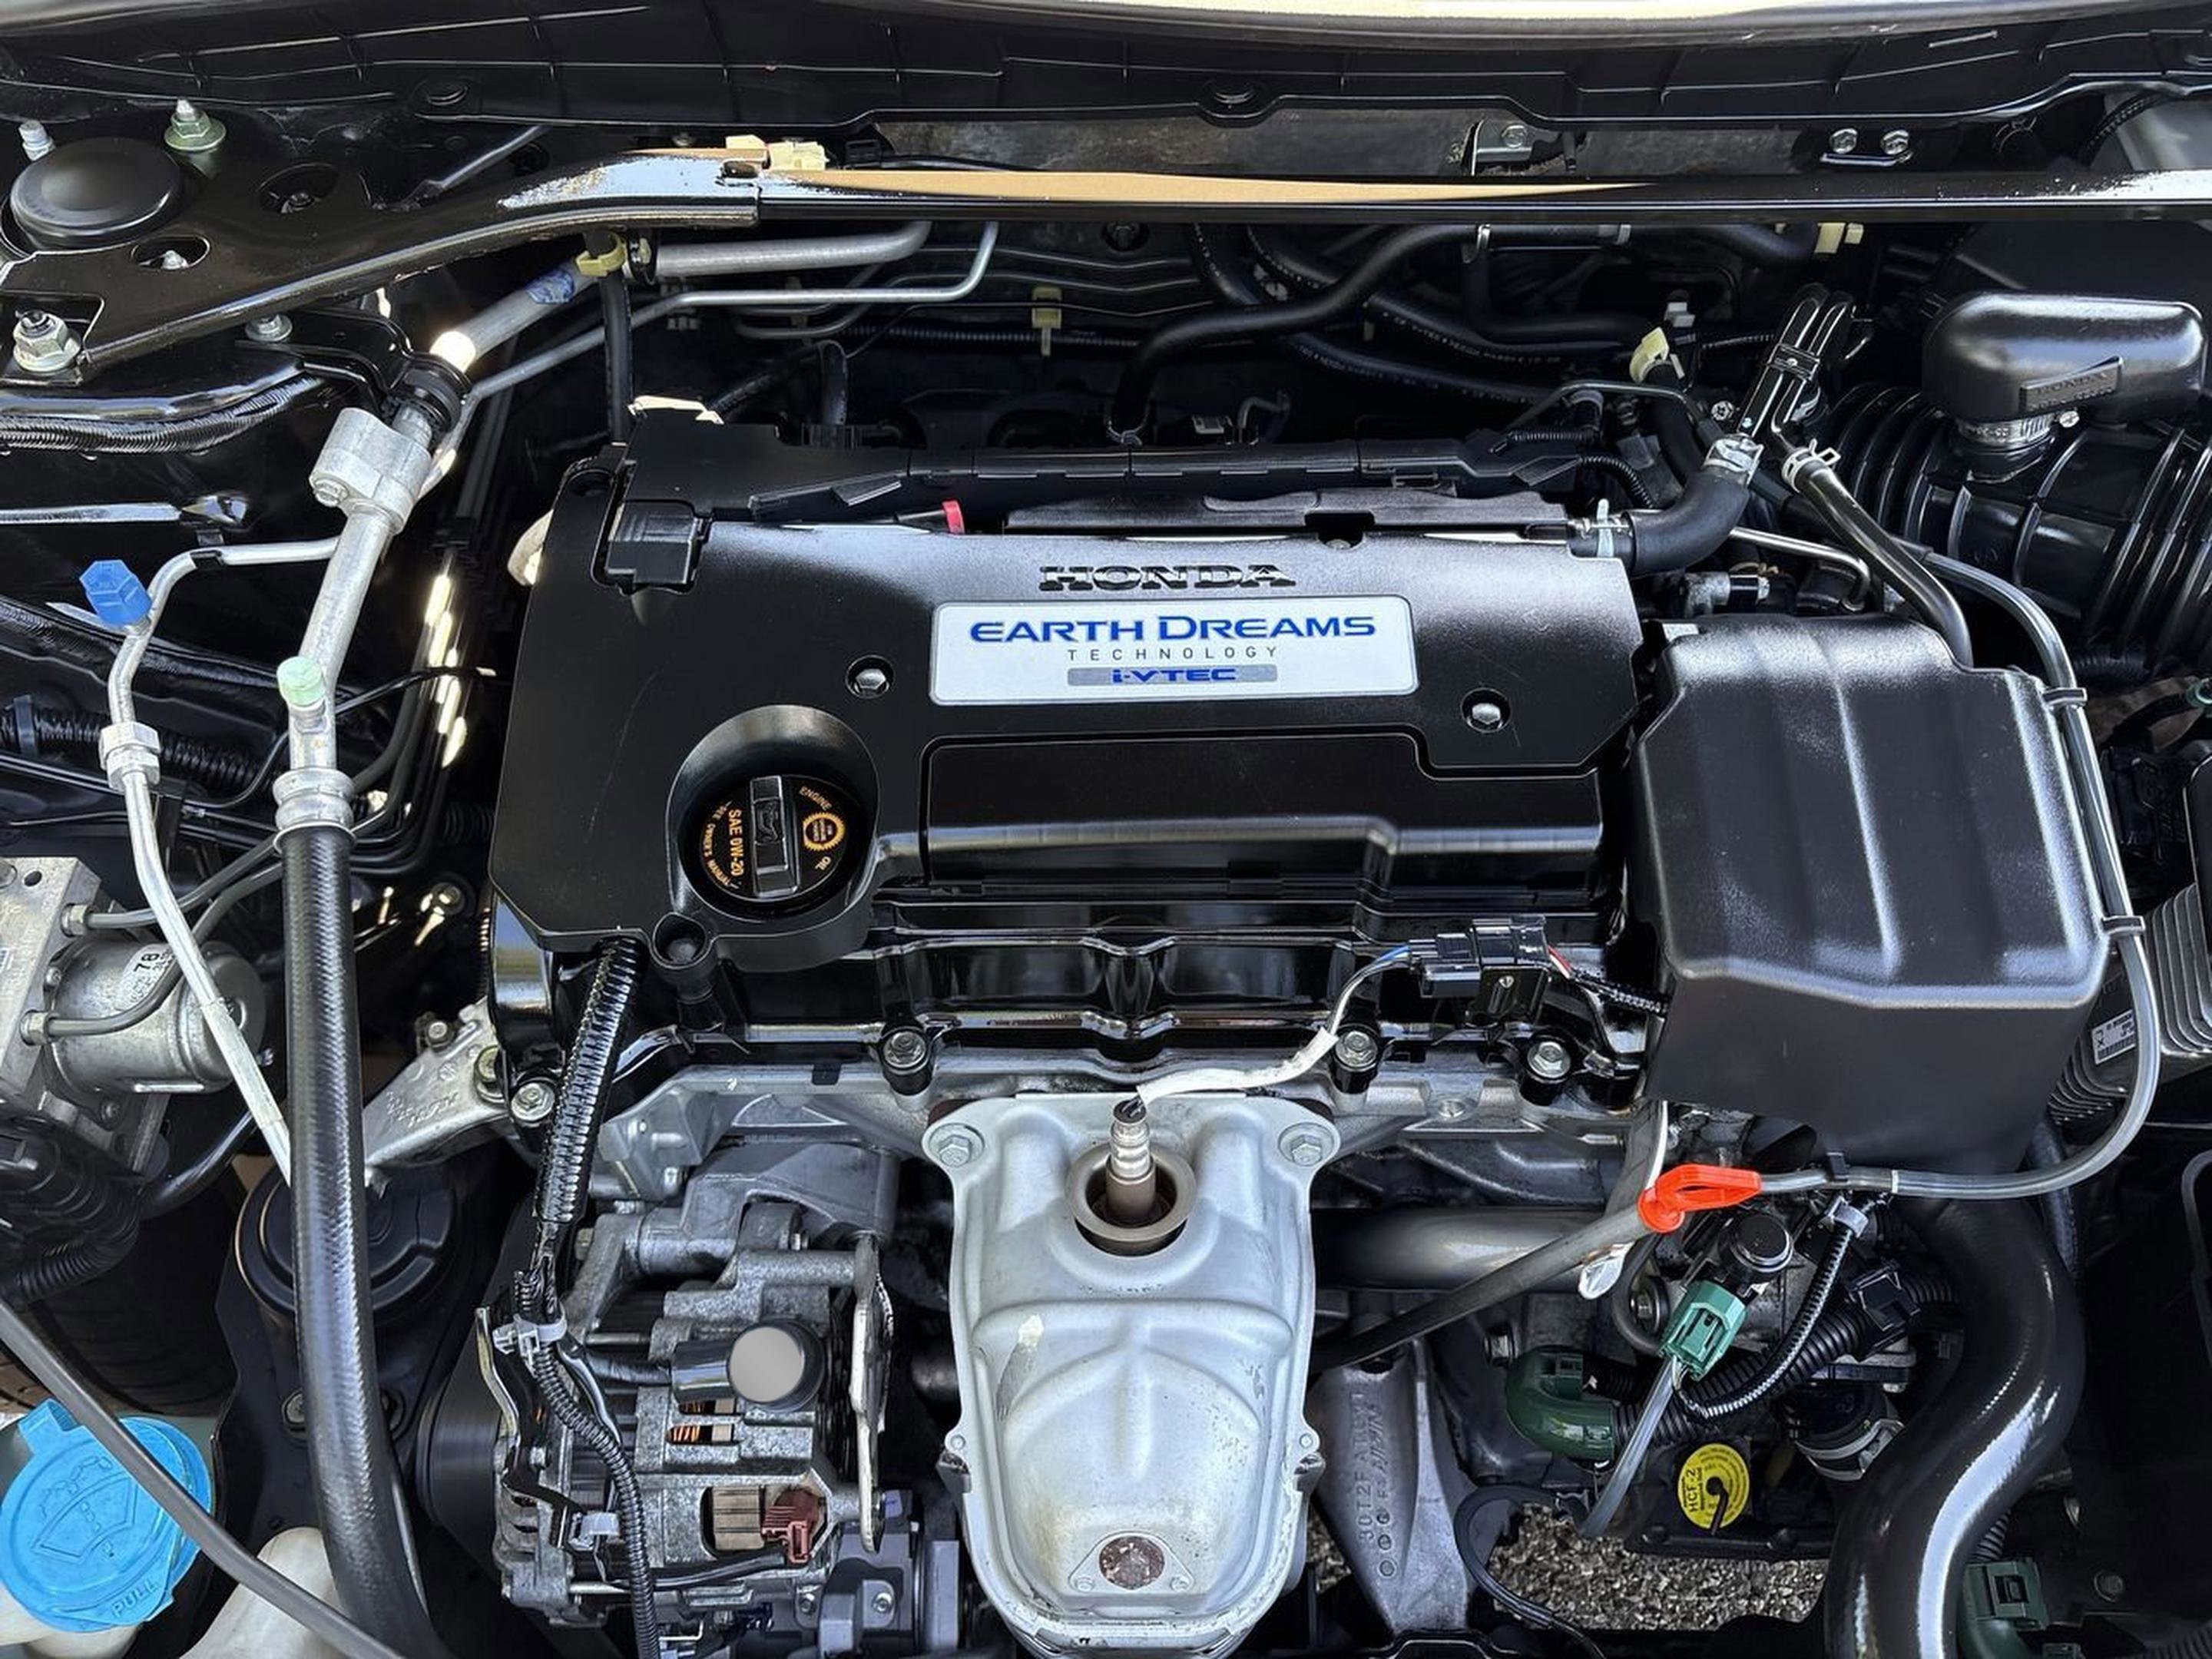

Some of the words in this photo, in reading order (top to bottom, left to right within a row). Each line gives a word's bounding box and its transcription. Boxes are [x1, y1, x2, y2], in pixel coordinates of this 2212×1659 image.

[1038, 565, 1296, 592] HONDA
[969, 621, 1144, 643] EARTH
[1157, 615, 1376, 641] DREAMS
[1068, 646, 1277, 661] TECHNOLOGY
[1111, 668, 1237, 684] i-VTEC
[799, 786, 832, 811] ENGINE
[728, 808, 743, 835] SAE
[730, 837, 744, 876] 0W-20
[815, 856, 832, 871] OIL
[134, 953, 160, 972] 78
[112, 1578, 159, 1618] PULL
